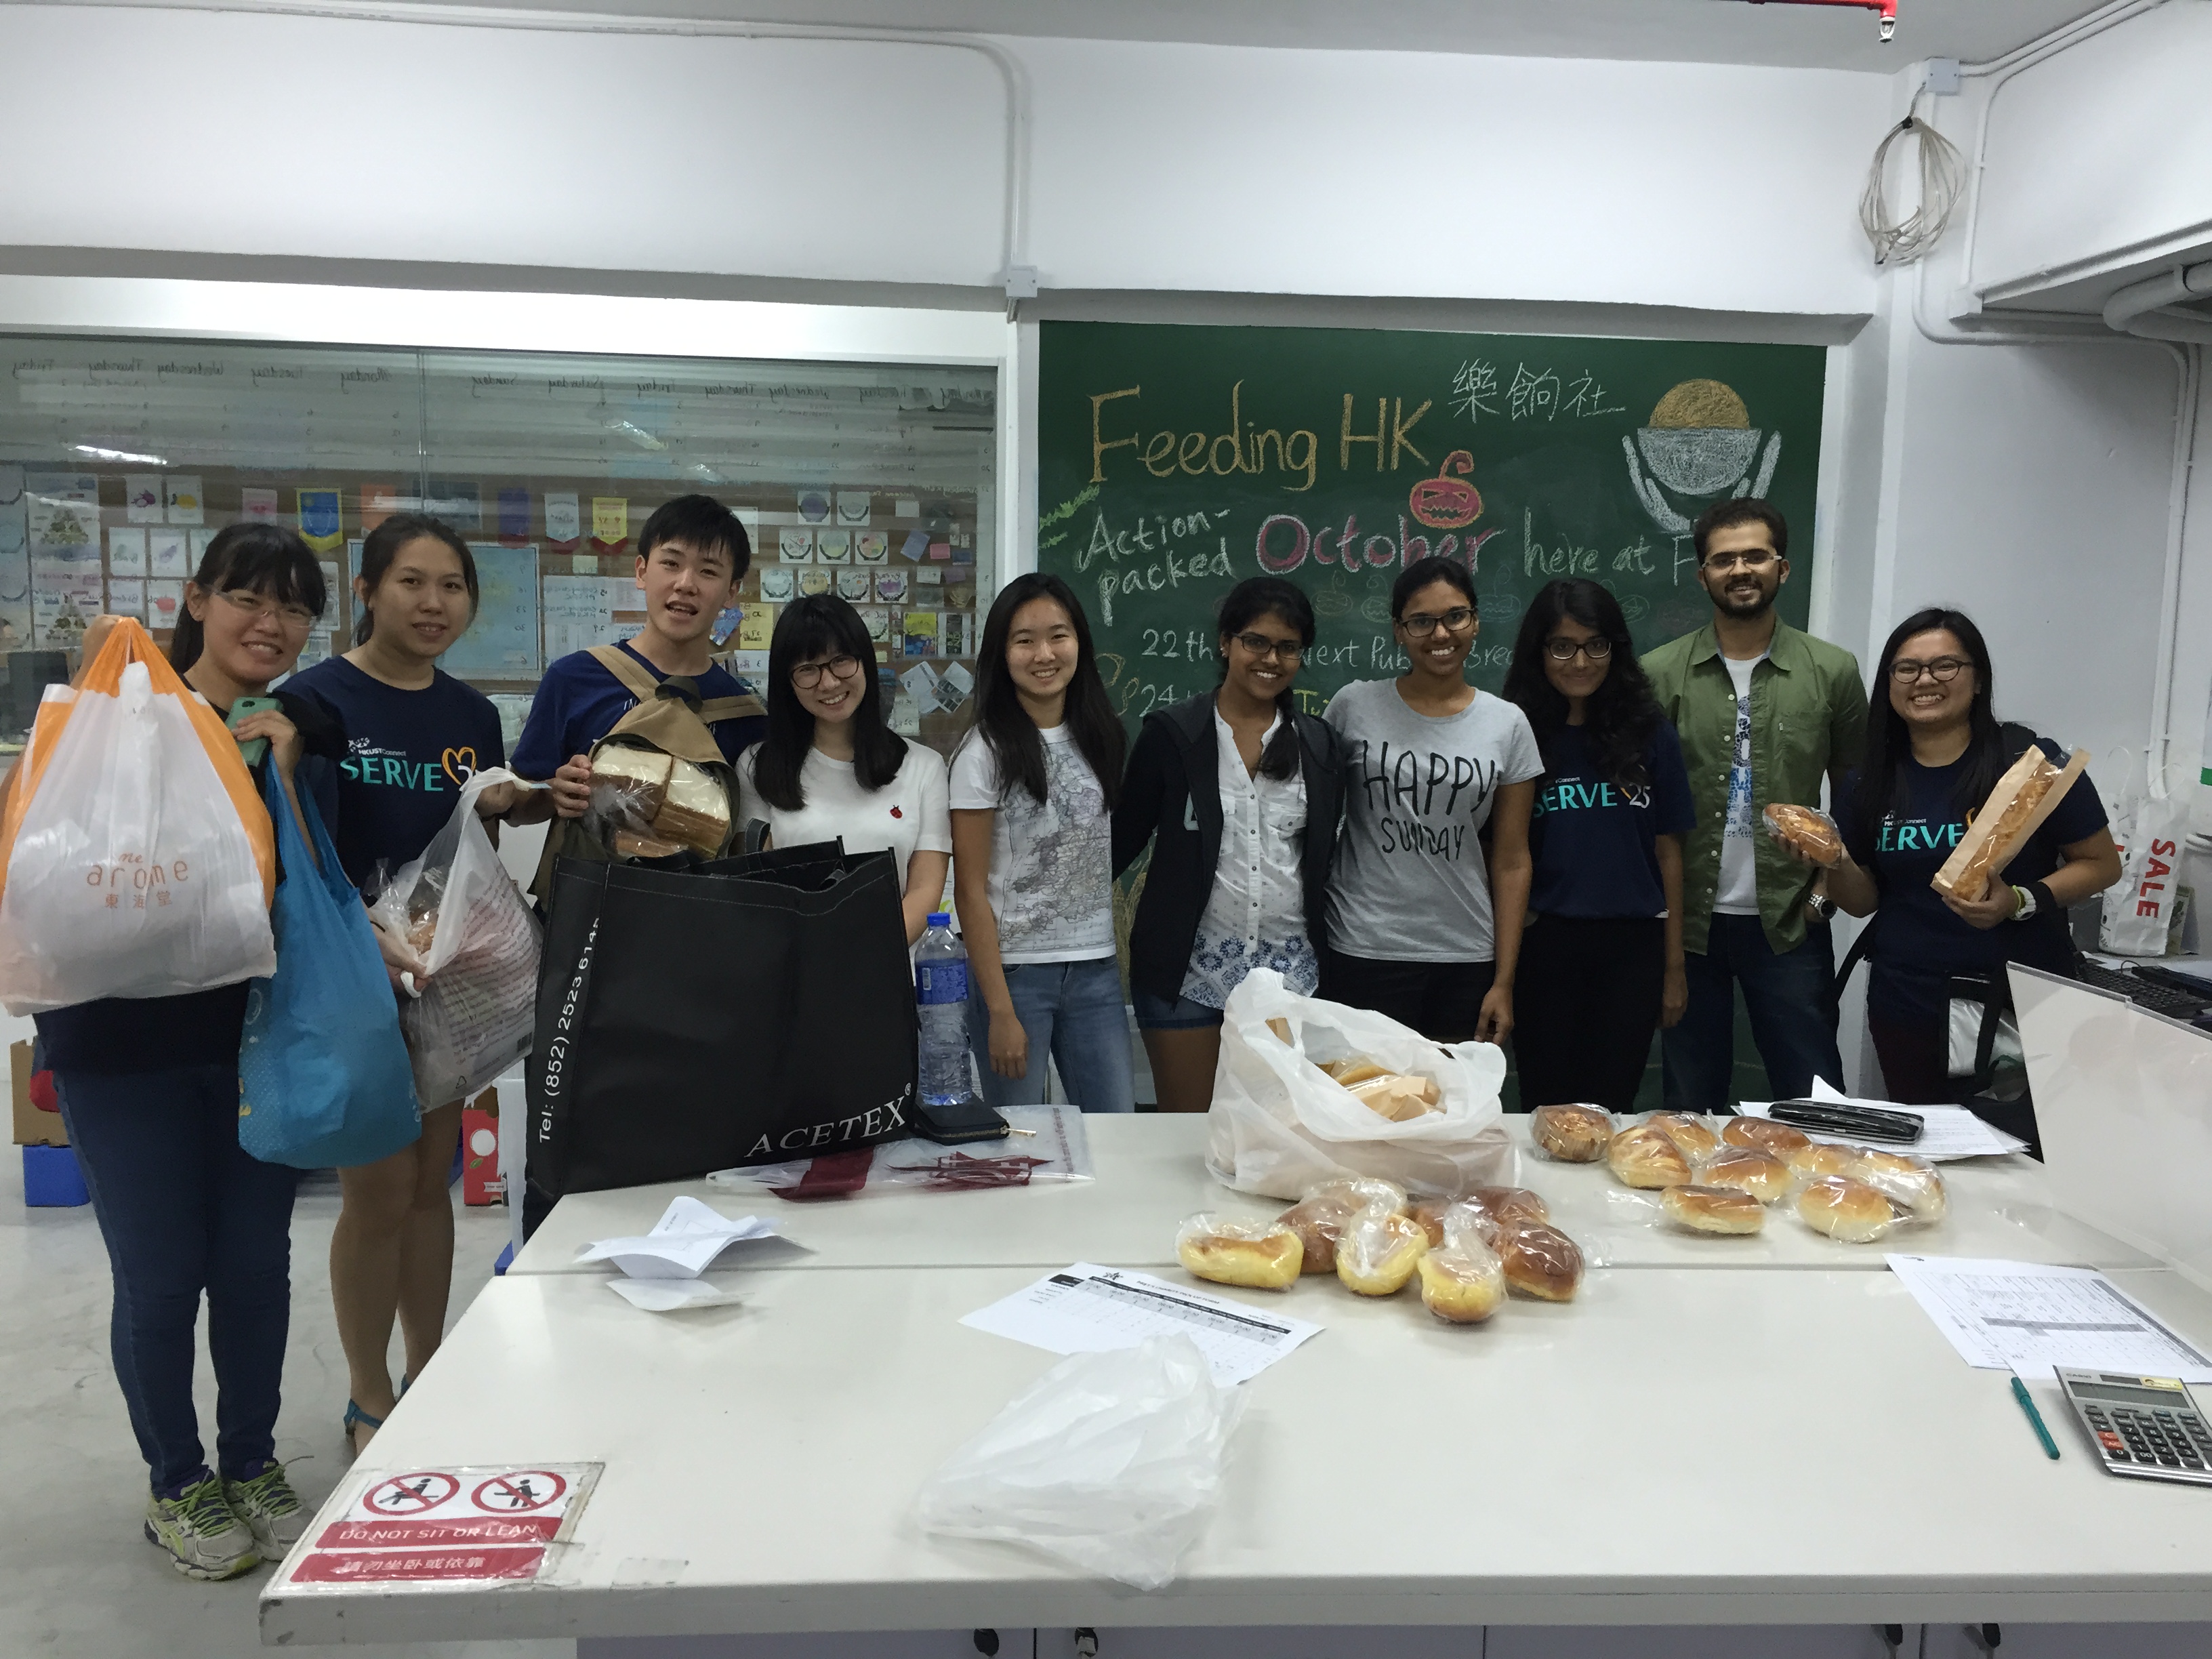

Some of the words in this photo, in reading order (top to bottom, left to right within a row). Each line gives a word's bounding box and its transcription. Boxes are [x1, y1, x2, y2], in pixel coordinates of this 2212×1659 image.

[1448, 358, 1626, 423] 樂餉社
[1087, 379, 1317, 491] Feeding
[1340, 393, 1432, 472] HK
[1073, 507, 1230, 573] Action-
[1256, 513, 1505, 575] October
[1524, 507, 1601, 577] here
[1612, 534, 1656, 576] at
[1671, 534, 1698, 587] F
[1098, 536, 1237, 627] packed
[1371, 636, 1413, 670] Pub
[340, 756, 444, 792] SERVE
[1362, 740, 1496, 816] HAPPY
[1629, 782, 1651, 808] 25
[1381, 817, 1465, 861] SUNDAY
[87, 861, 189, 889] arome
[104, 891, 173, 909] 東海堂
[2136, 838, 2176, 919] SALE
[558, 977, 582, 1031] 2523
[544, 1036, 570, 1097] (852)
[539, 1104, 554, 1143] Tel:
[340, 1530, 367, 1539] DO
[373, 1530, 413, 1539] NOT
[417, 1529, 446, 1539] SIT
[453, 1528, 479, 1537] OR
[485, 1524, 537, 1537] LEAN
